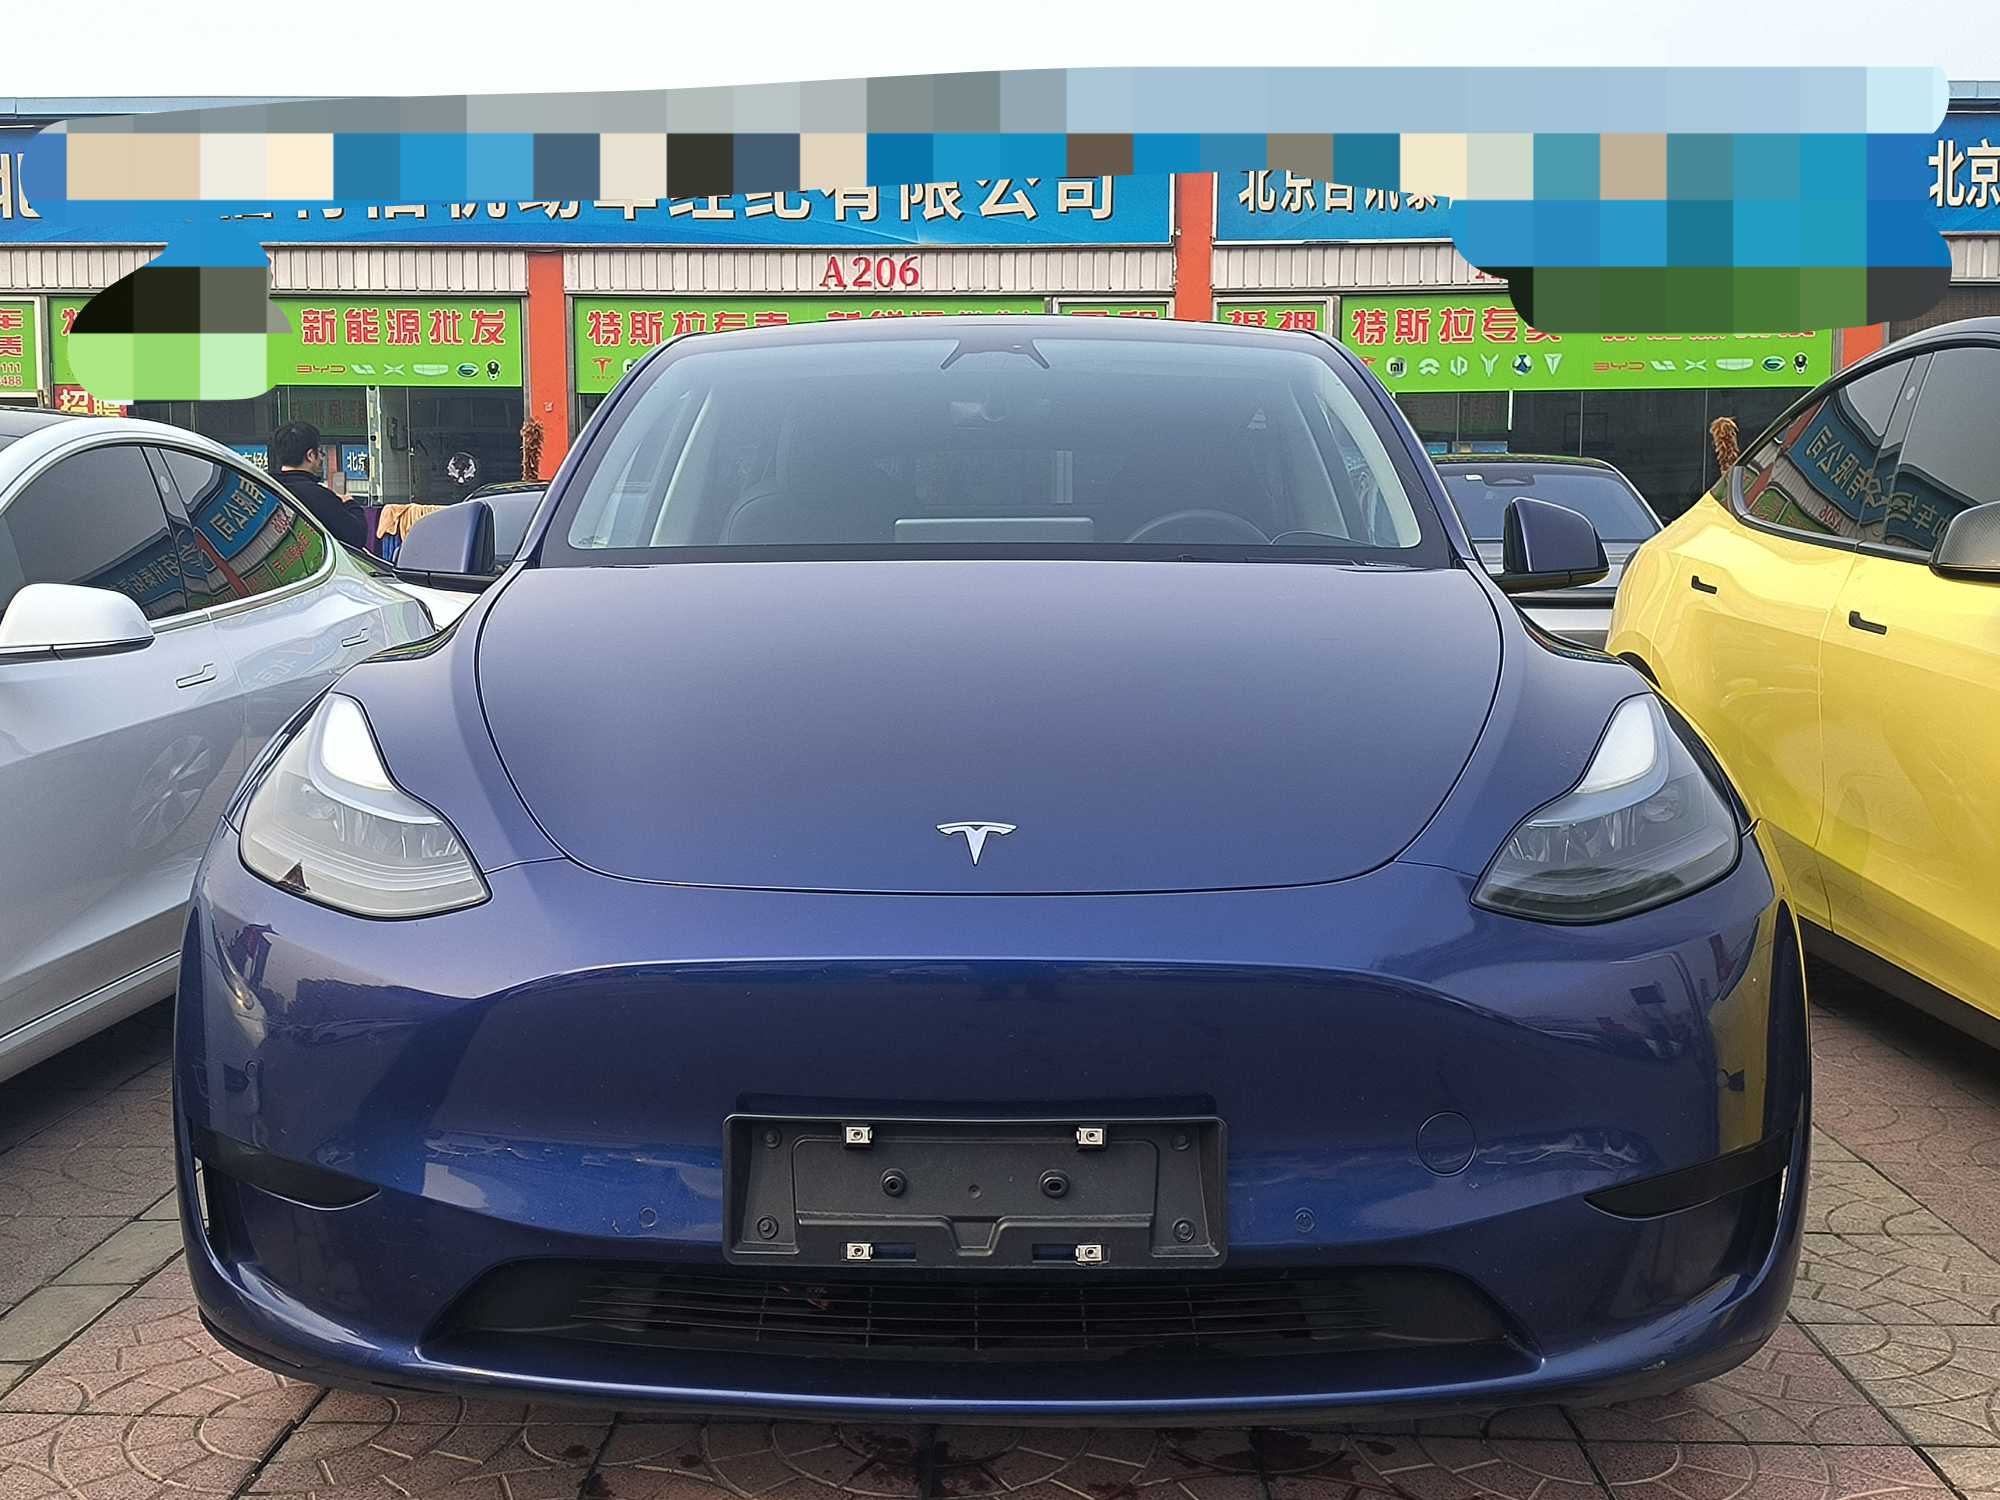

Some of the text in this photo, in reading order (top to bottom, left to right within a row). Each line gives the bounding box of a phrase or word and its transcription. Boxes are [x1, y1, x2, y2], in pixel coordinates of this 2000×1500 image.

[1926, 138, 2000, 209] 北京
[819, 256, 920, 288] A206
[301, 308, 506, 346] 新能源批发
